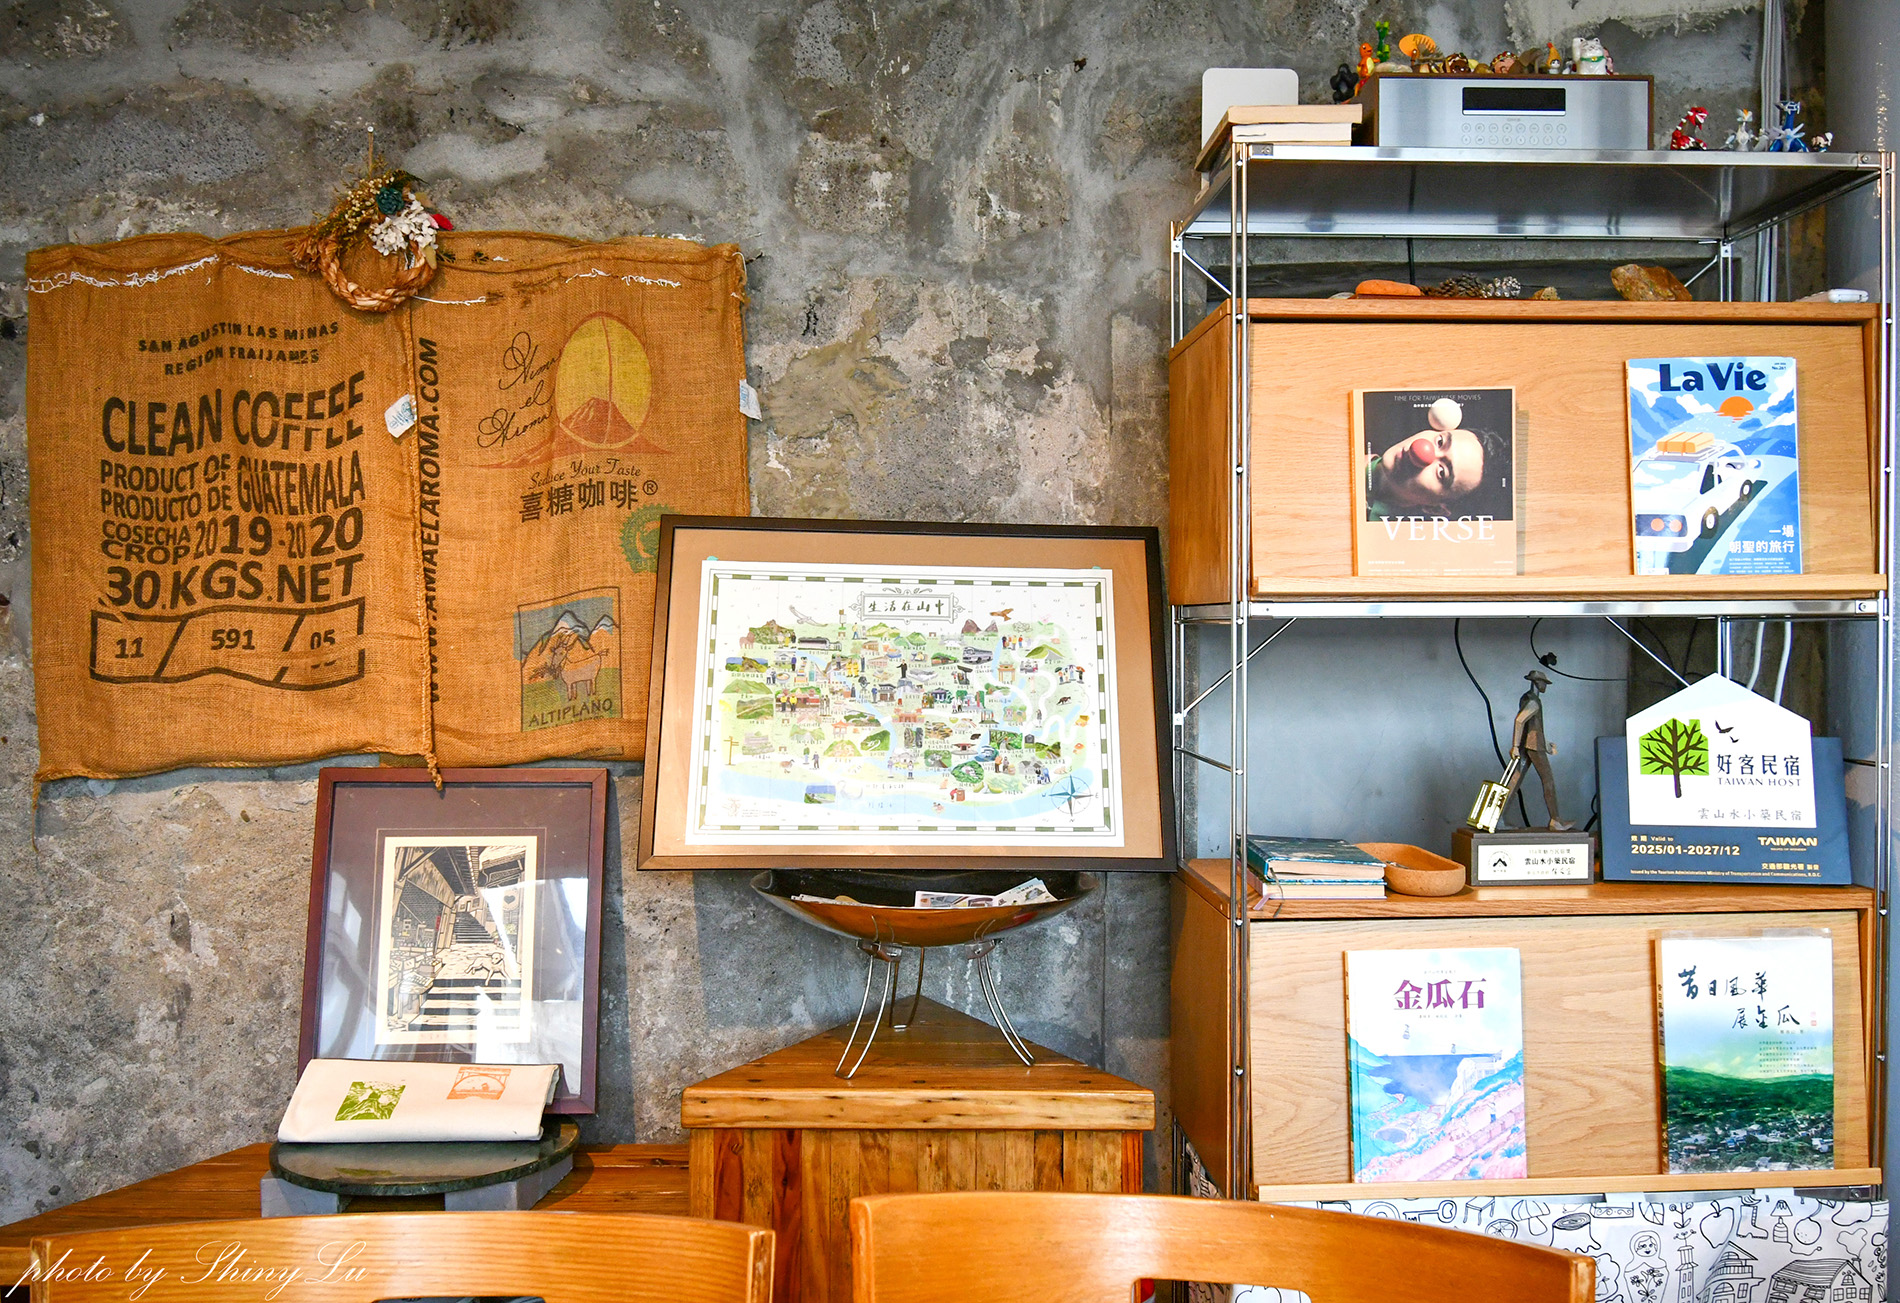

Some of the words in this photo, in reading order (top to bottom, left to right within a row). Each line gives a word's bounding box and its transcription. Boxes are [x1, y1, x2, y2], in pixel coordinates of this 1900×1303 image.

[138, 339, 172, 353] SAN
[178, 322, 242, 351] AGUSTIN
[247, 325, 278, 339] LAS
[284, 321, 339, 341] MINAS
[164, 346, 224, 376] REGION
[519, 380, 555, 409] el
[102, 388, 223, 456] CLEAN
[232, 370, 366, 452] COFFEE
[100, 460, 197, 494] PRODUCT
[203, 453, 231, 484] OF
[237, 450, 367, 517] GUATEMALA
[528, 468, 566, 490] Seduce
[570, 460, 601, 478] Your
[604, 457, 642, 477] Taste
[101, 487, 201, 523] PRODUCTO
[207, 485, 232, 513] DE
[519, 478, 639, 523] 喜糖咖啡
[102, 519, 192, 546] COSECHA
[1380, 515, 1495, 543] VERSE
[1769, 525, 1795, 537] 一場
[101, 541, 192, 565] CROP
[1729, 540, 1795, 553] 朝聖的旅行
[114, 637, 145, 659] 11
[210, 628, 256, 651] 591
[528, 698, 613, 728] ALTIPLANO
[1717, 754, 1800, 776] 好客民宿
[1718, 777, 1763, 786] TAIWAN
[1769, 778, 1801, 787] HOST
[1698, 808, 1801, 821] 雲山水小築民宿
[1631, 844, 1740, 856] 2025/01-2027/12
[1757, 836, 1818, 847] TAIWAN
[1393, 978, 1487, 1010] 金瓜石
[1678, 965, 1768, 1000] 昔日風華
[1731, 1005, 1800, 1029] 展金瓜
